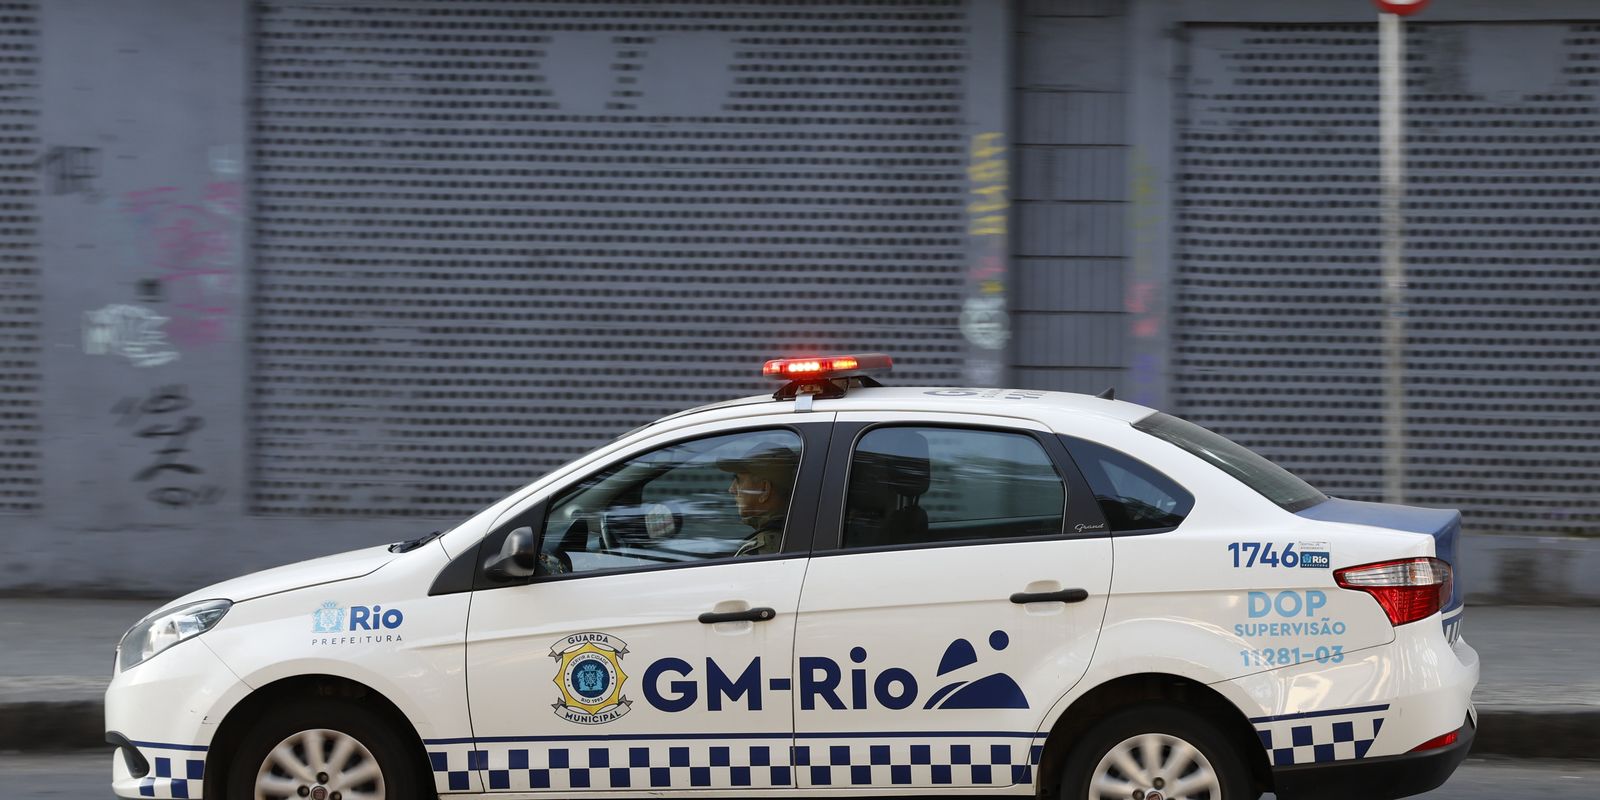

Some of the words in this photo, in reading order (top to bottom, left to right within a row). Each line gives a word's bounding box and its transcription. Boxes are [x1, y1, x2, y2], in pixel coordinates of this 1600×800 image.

[1228, 542, 1299, 568] 1746
[1312, 555, 1328, 564] Rio
[1247, 590, 1327, 618] DOP
[349, 605, 404, 631] Rio
[1234, 617, 1346, 637] SUPERVISÃO
[312, 634, 402, 645] PREFEITURA
[567, 634, 609, 644] GUARDA
[642, 646, 919, 713] GM-Rio
[564, 710, 622, 723] MUNICIPAL
